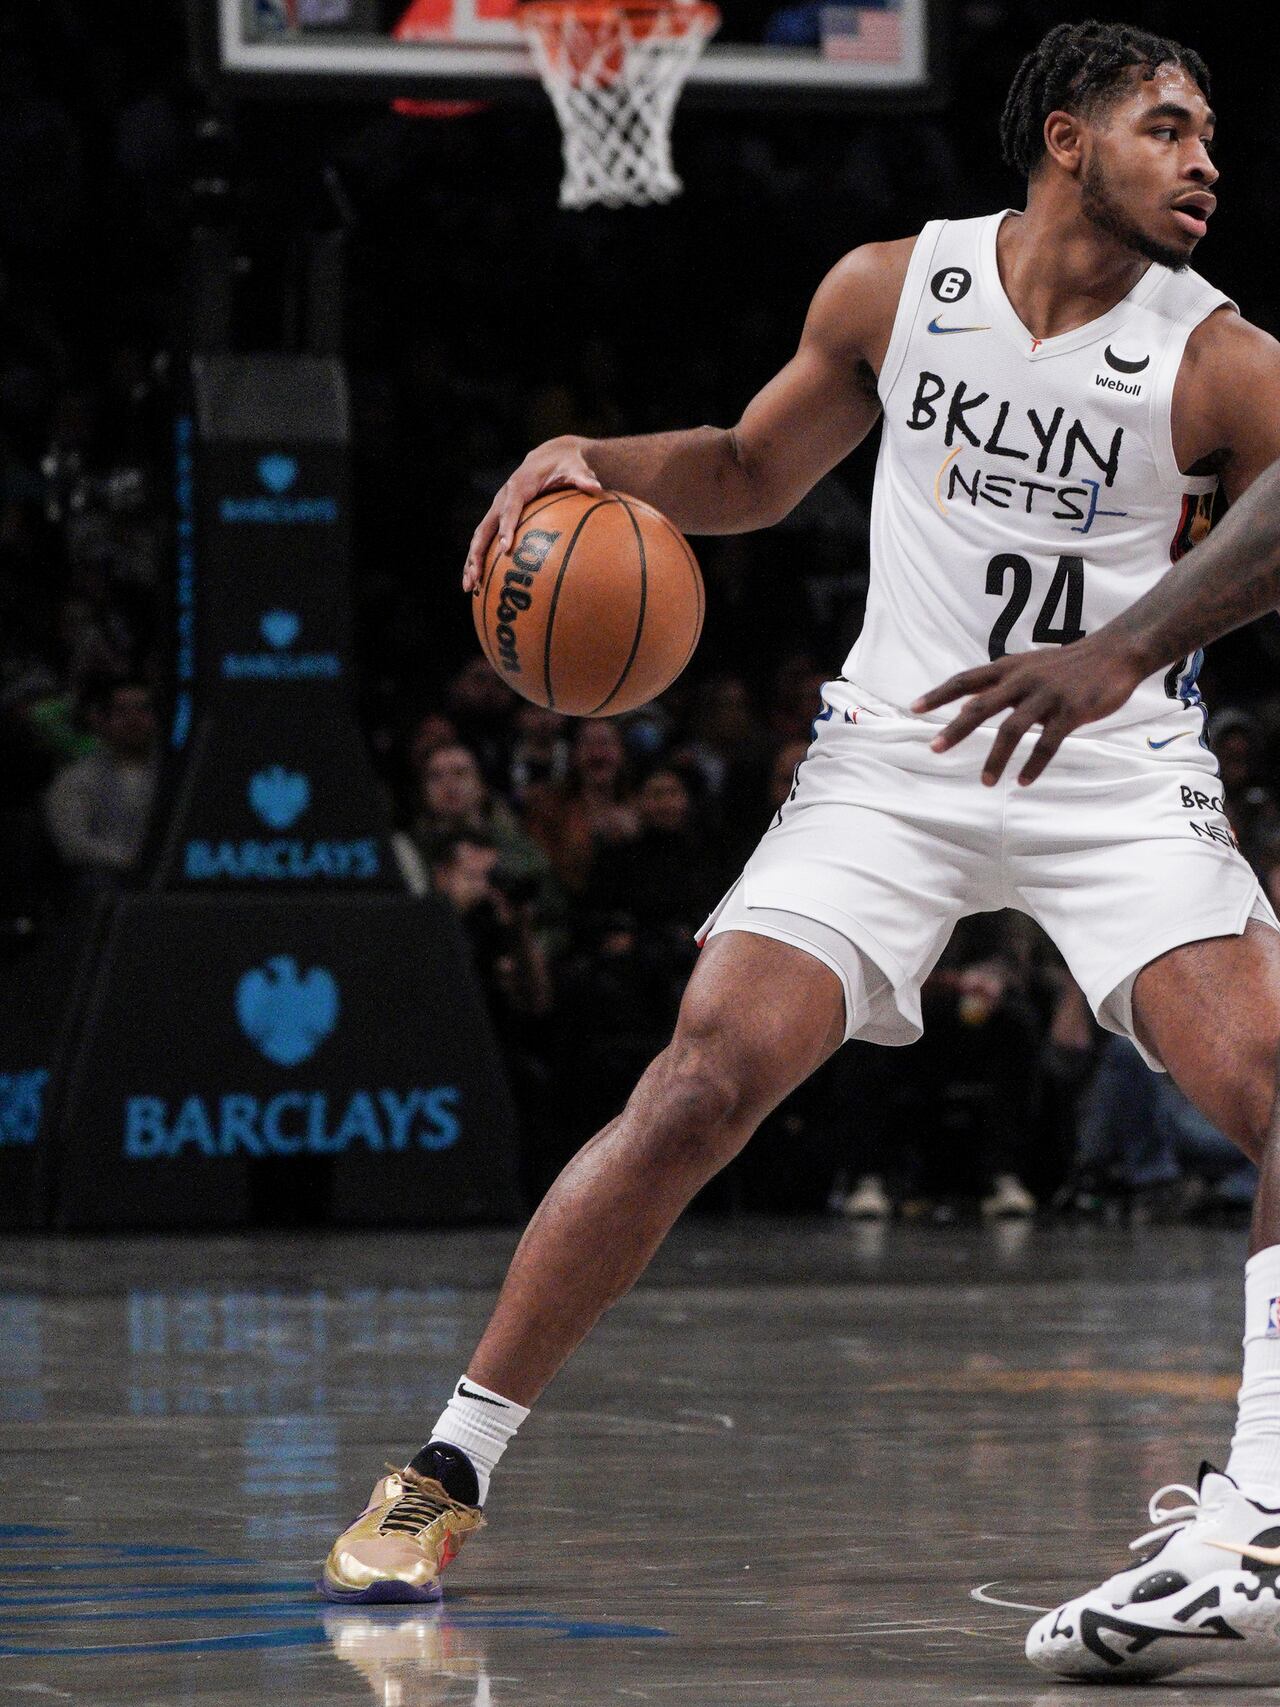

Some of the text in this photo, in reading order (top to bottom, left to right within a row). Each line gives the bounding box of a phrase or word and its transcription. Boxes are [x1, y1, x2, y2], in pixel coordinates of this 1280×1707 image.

[938, 271, 965, 299] 6
[1095, 374, 1142, 397] Webull
[906, 371, 1125, 487] BKLYN
[496, 528, 563, 674] Wilson
[985, 553, 1087, 662] 24
[185, 839, 380, 881] BARCLAYS
[124, 1086, 461, 1159] BARCLAYS
